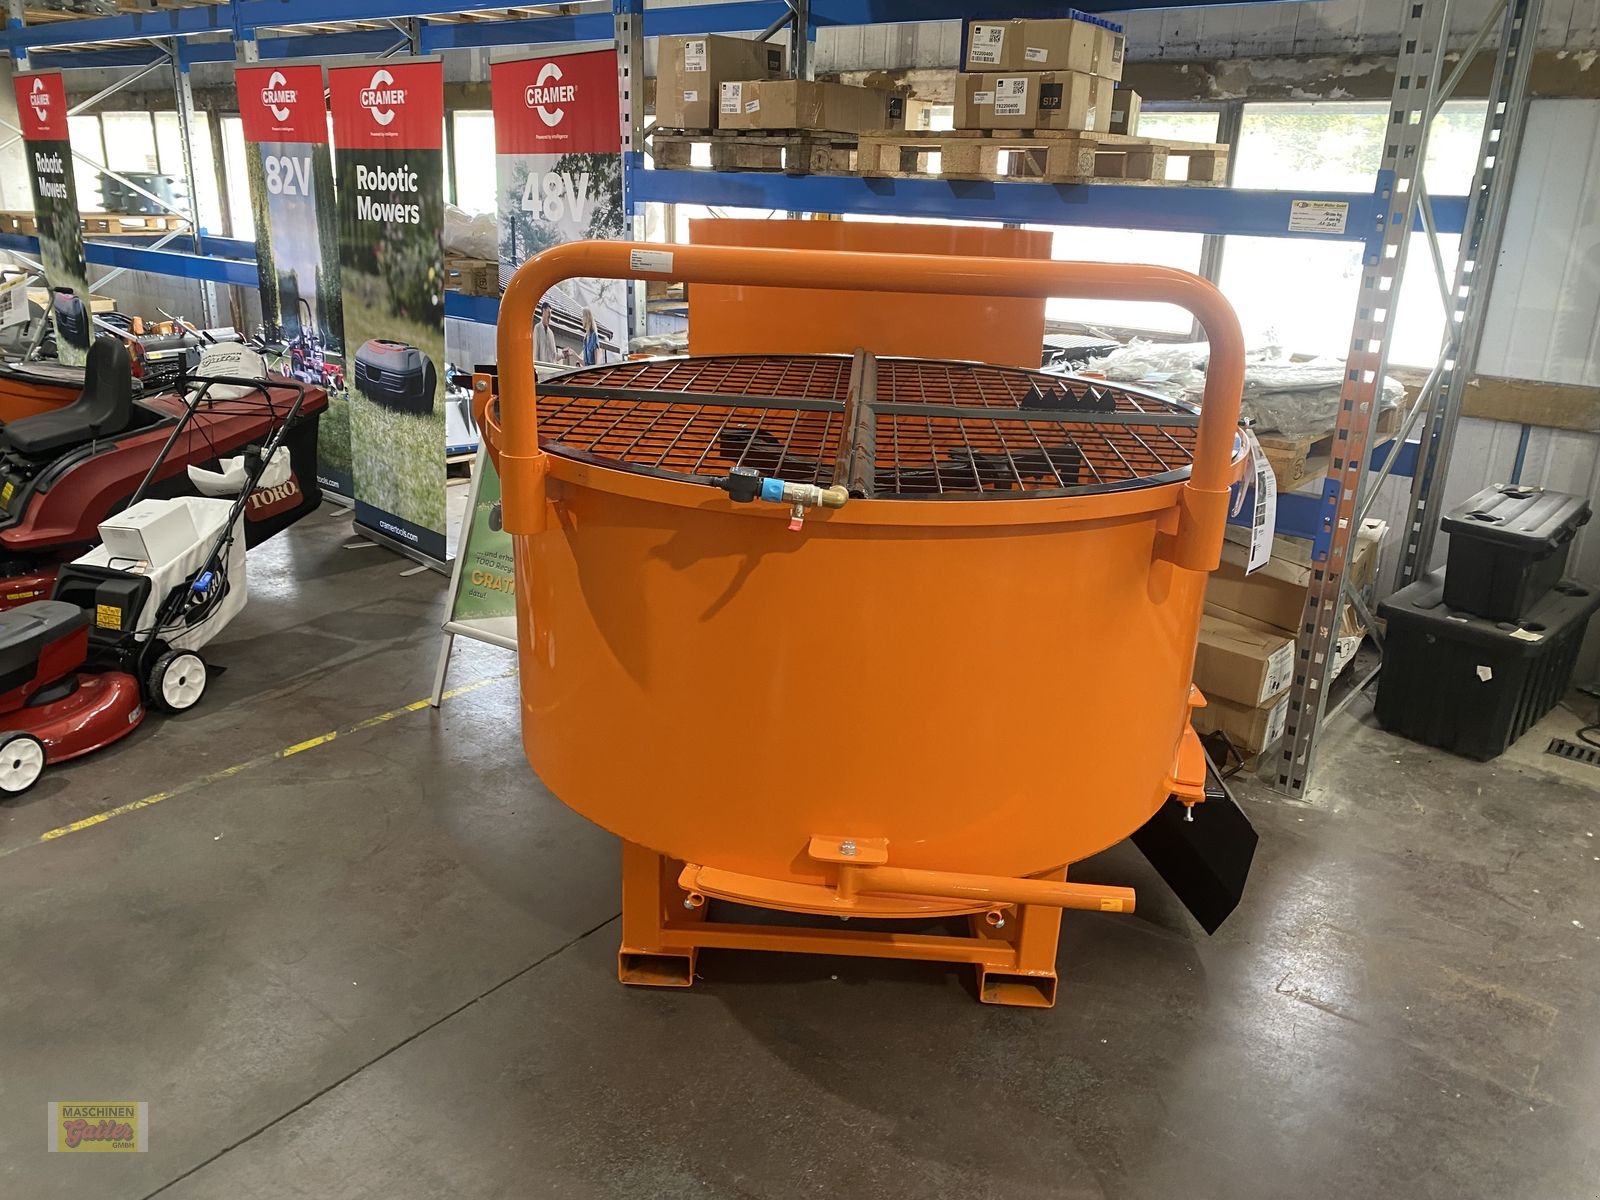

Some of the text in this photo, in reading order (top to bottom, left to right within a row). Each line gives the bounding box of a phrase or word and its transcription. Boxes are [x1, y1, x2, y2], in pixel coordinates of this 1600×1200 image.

[29, 93, 50, 106] CRAMER
[262, 89, 297, 104] CRAMER
[361, 89, 405, 106] CRAMER
[526, 85, 575, 105] CRAMER
[1042, 96, 1059, 106] SIP
[35, 151, 64, 174] Robotic
[265, 155, 311, 196] 82V
[356, 164, 418, 193] Robotic
[38, 176, 67, 199] Mowers
[522, 171, 589, 223] 48V
[357, 195, 420, 224] Mowers
[316, 475, 340, 489] tools.com
[249, 480, 297, 510] TORO
[379, 520, 419, 543] cramertools.com
[476, 557, 495, 568] TORO
[468, 588, 487, 599] dazu!
